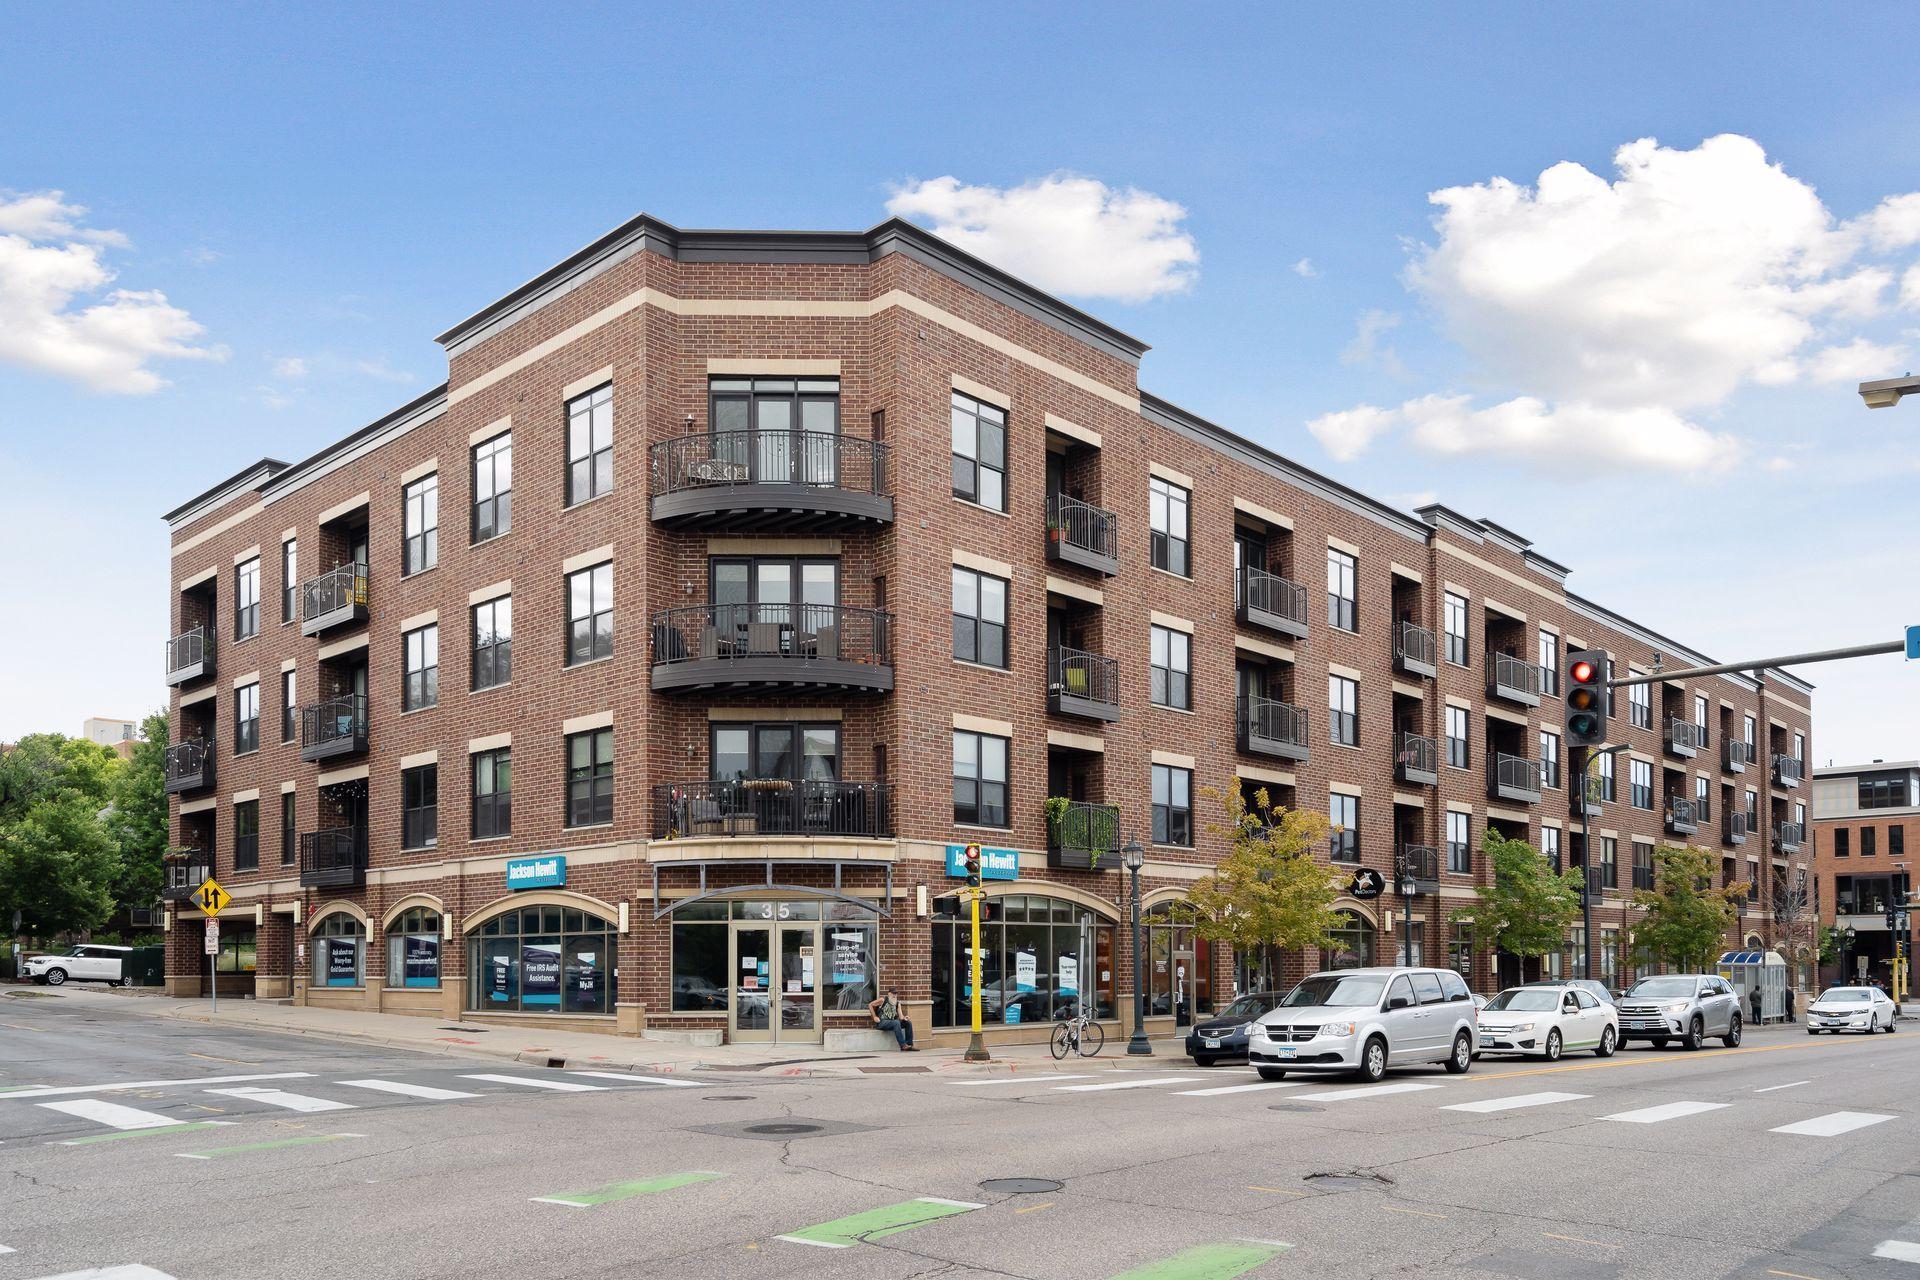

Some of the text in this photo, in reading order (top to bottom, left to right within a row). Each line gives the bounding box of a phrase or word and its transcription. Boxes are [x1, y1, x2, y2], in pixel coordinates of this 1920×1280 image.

[954, 849, 1016, 870] Jacn Hewitt
[509, 859, 557, 880] Jackson Hewitt
[836, 944, 860, 952] Drop-off
[526, 963, 559, 972] Free IRS Audit
[528, 974, 556, 982] Assistance.
[579, 981, 594, 991] MyJH
